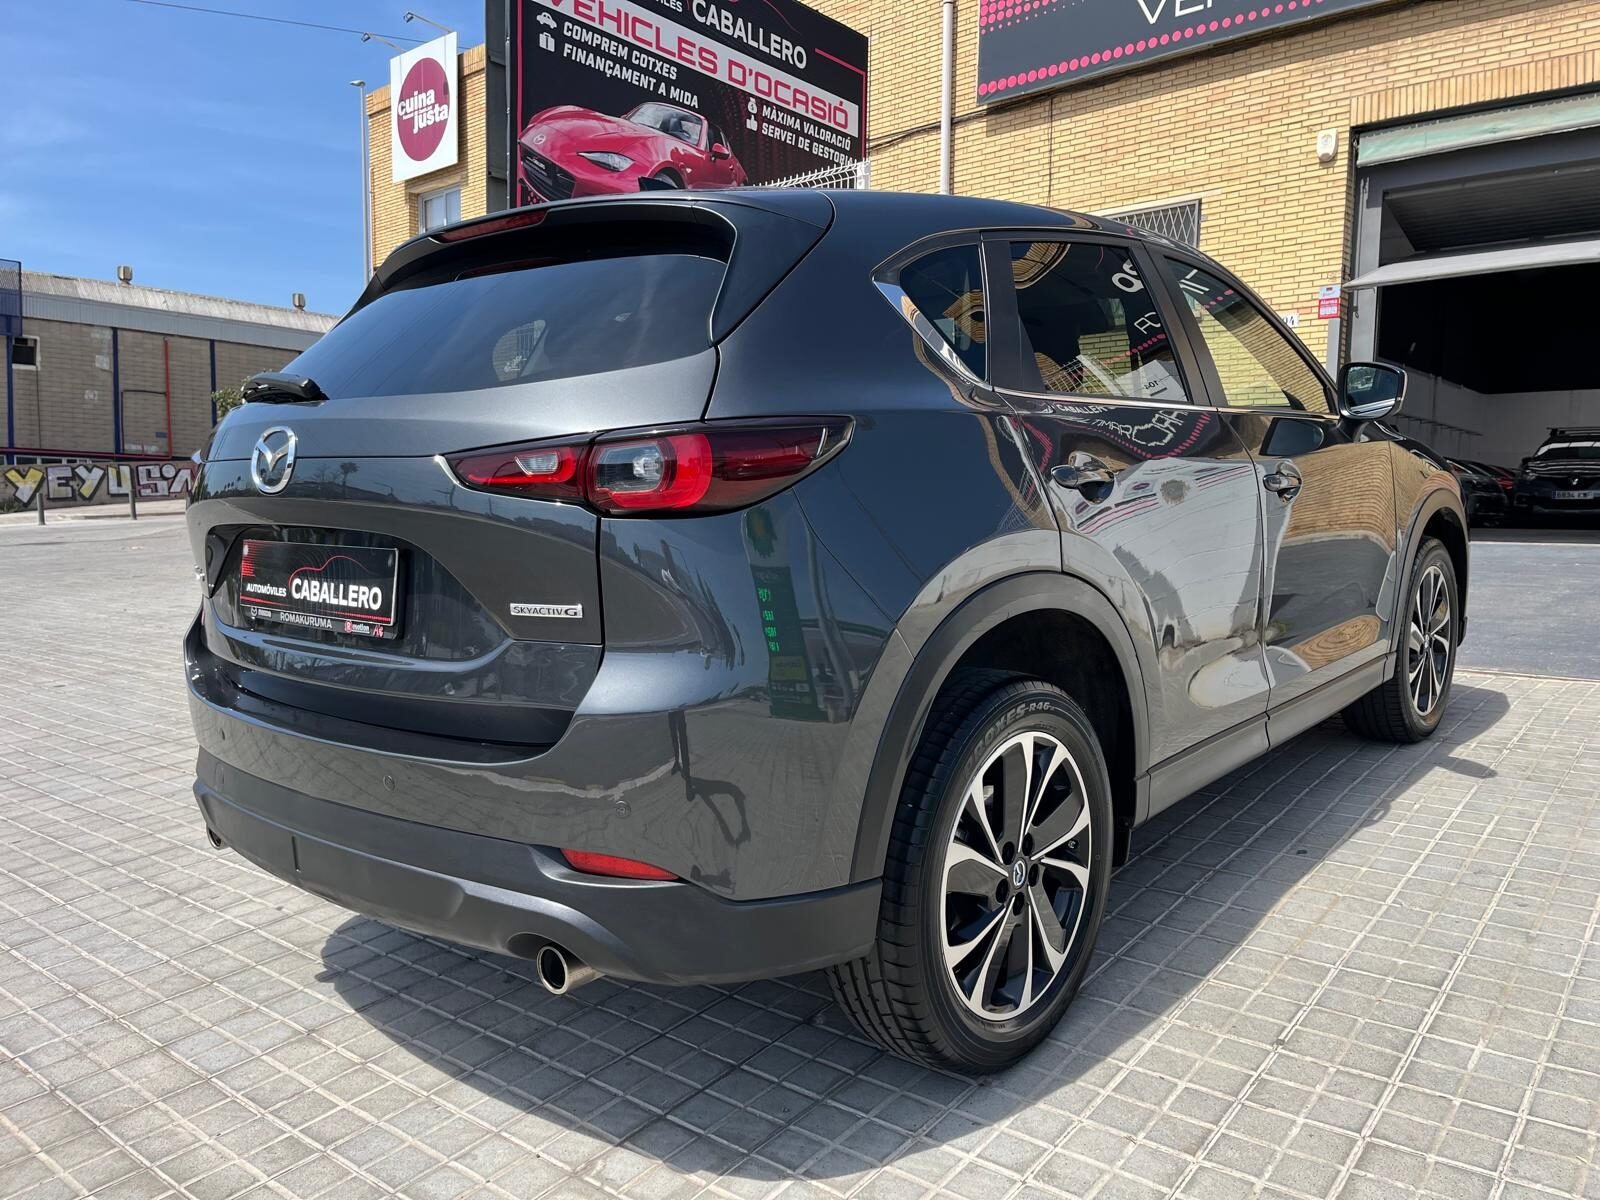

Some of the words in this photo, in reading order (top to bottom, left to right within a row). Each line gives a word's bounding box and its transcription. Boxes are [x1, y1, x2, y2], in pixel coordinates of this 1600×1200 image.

[563, 21, 628, 60] COMPREM
[632, 50, 678, 80] COTXES
[692, 0, 807, 69] CABALLERO
[563, 43, 656, 92] FINANÇAMENT
[658, 82, 666, 96] A
[669, 86, 699, 109] MIDA
[398, 89, 435, 117] cuina
[413, 103, 448, 134] justa
[761, 122, 796, 146] SERVEI
[798, 137, 810, 151] DE
[762, 104, 801, 131] MÀXIMA
[803, 121, 851, 151] VALORACIÓ
[246, 582, 287, 597] AUTOMÓVILES
[291, 577, 382, 611] CABALLERO
[280, 611, 333, 629] ROMAKURUMA
